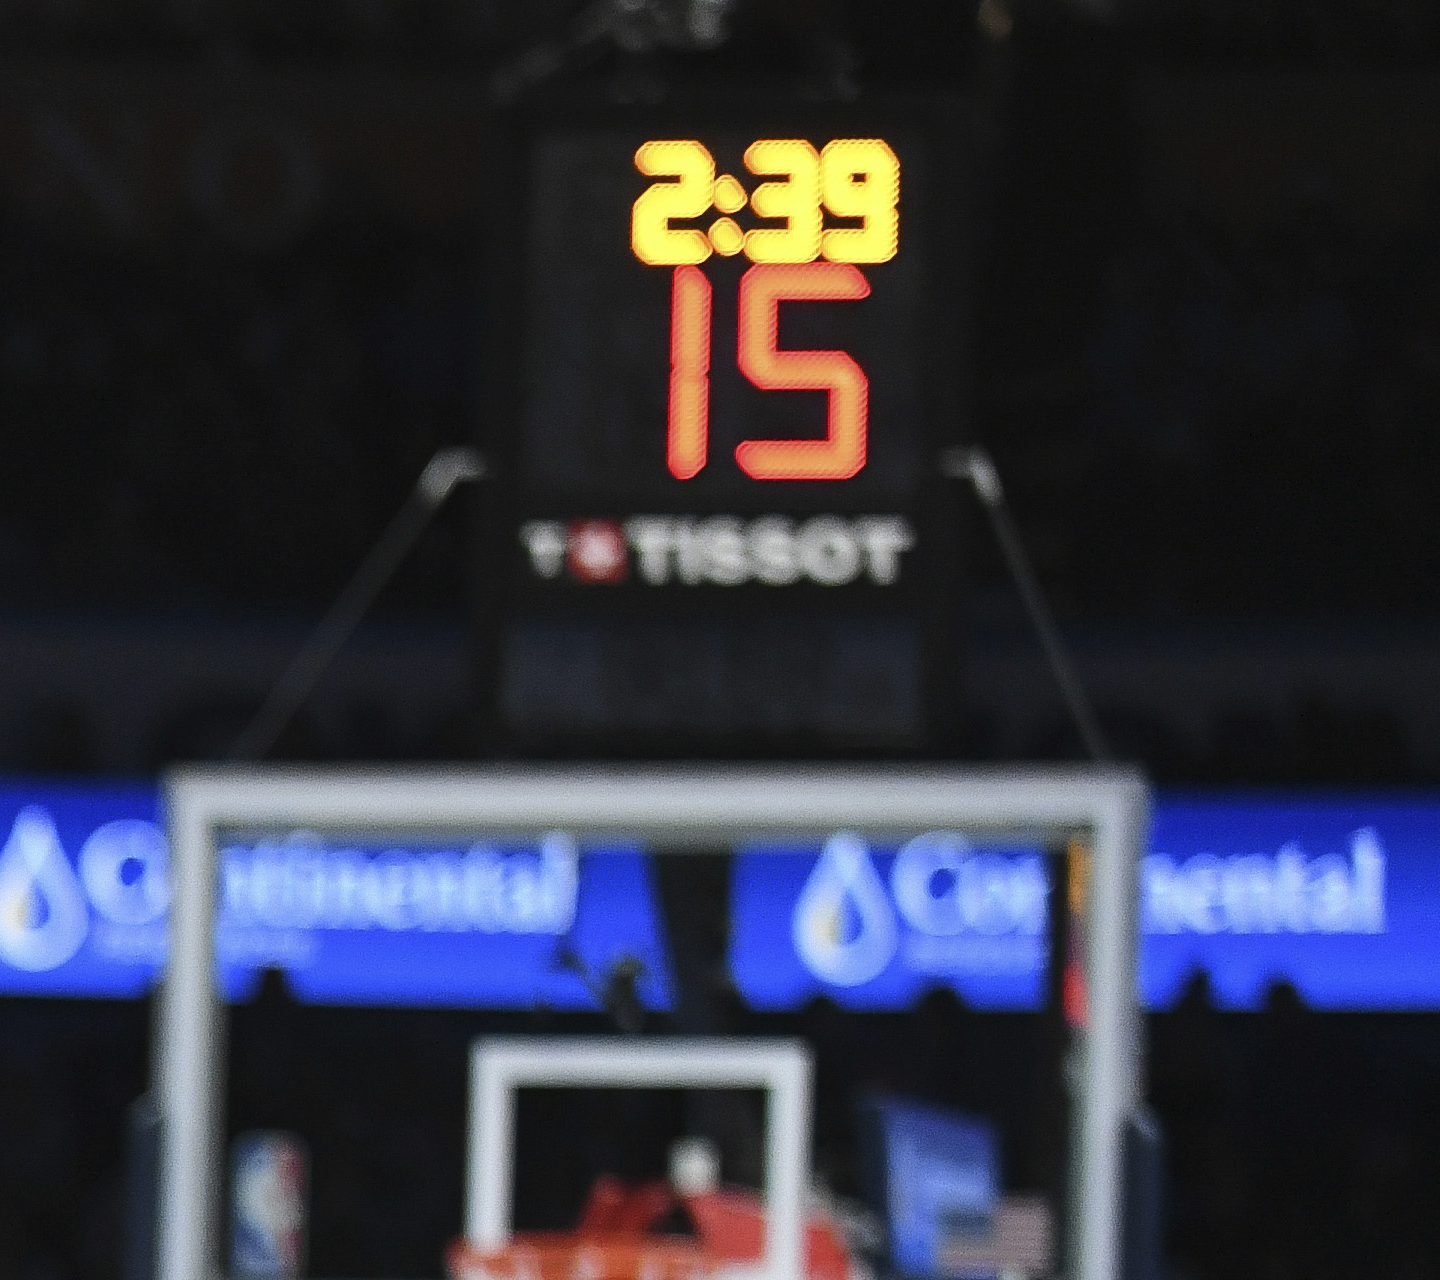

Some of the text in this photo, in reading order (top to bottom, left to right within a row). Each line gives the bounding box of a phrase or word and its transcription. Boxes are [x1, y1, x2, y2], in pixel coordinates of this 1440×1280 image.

[632, 139, 900, 265] 2:39
[667, 263, 871, 480] 15
[627, 516, 917, 587] TISSOT
[80, 818, 579, 935] Cntinental
